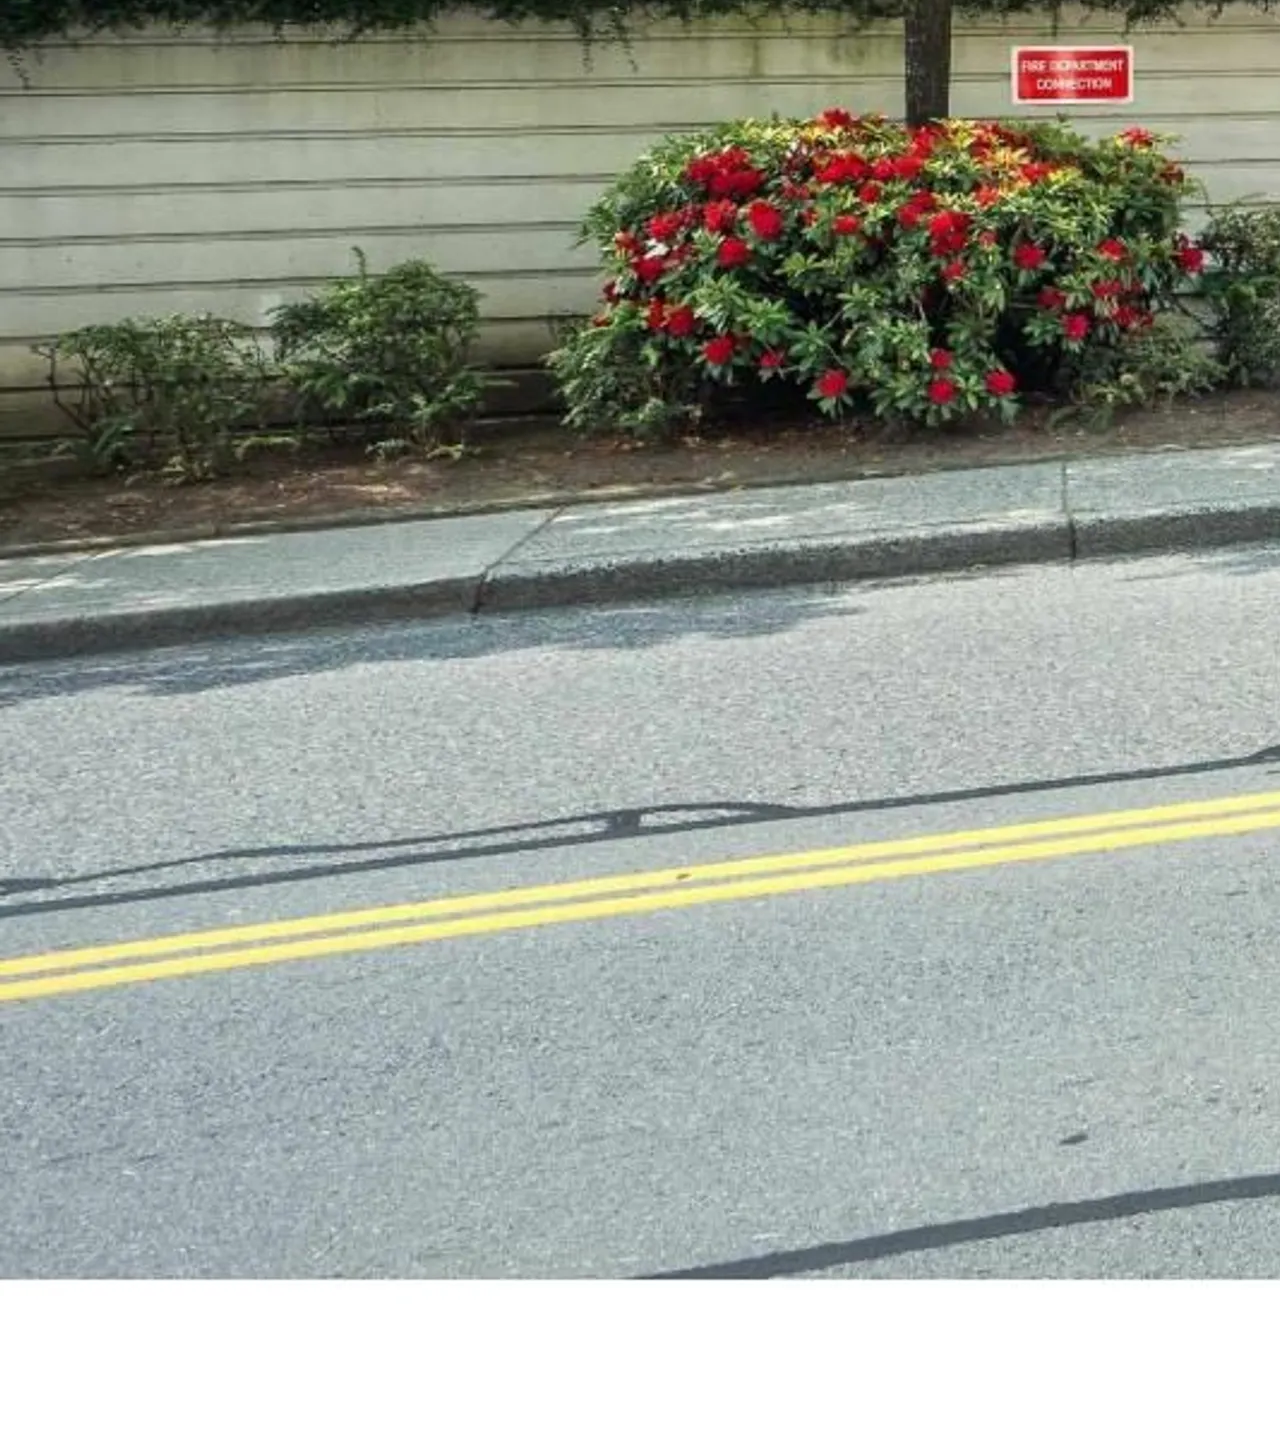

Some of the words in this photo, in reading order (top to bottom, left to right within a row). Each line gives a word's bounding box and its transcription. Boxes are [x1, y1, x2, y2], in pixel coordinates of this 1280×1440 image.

[1021, 60, 1047, 72] FIRE
[1049, 59, 1124, 72] DEPARTMENT
[1036, 78, 1113, 90] CONNECTION
